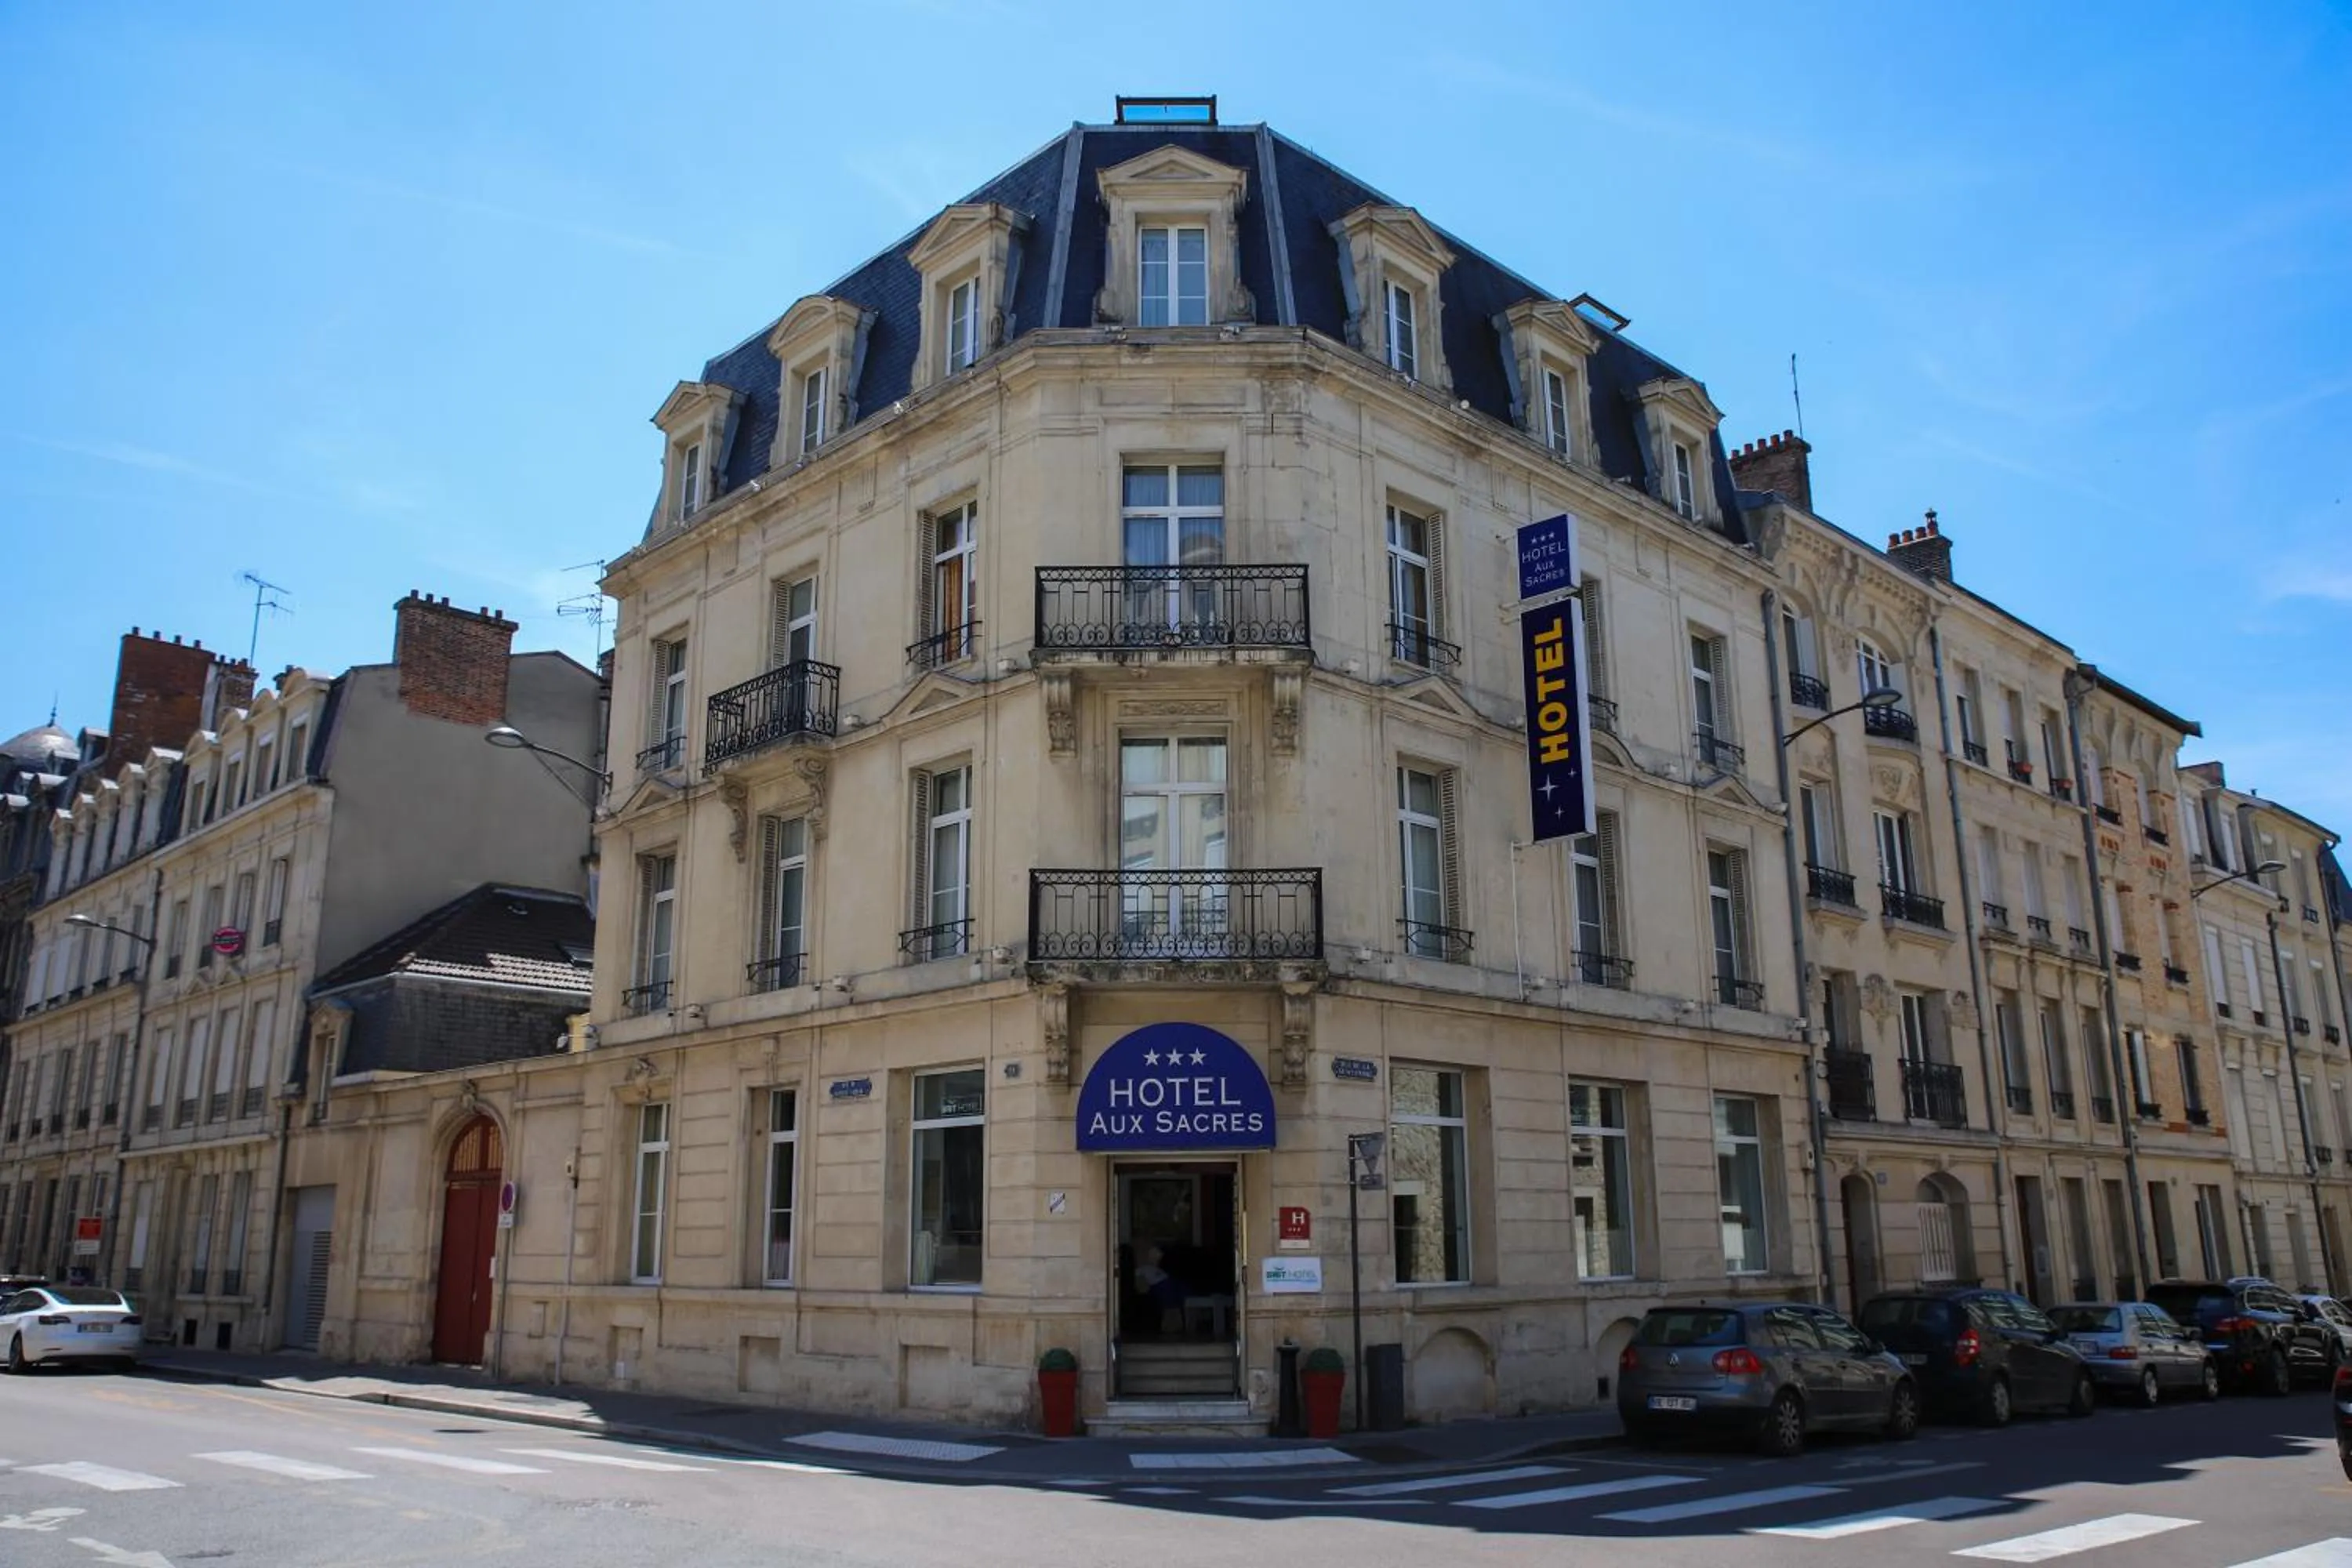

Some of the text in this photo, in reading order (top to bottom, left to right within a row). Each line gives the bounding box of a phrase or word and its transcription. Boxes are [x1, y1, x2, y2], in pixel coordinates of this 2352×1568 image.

[1521, 542, 1566, 564] HOTEL
[1525, 568, 1566, 587] SACRES
[1534, 560, 1555, 573] AUX
[1534, 617, 1570, 765] HOTEL
[1109, 1076, 1242, 1108] HOTEL
[1088, 1110, 1264, 1135] AUX SACRES
[1291, 1211, 1306, 1225] H
